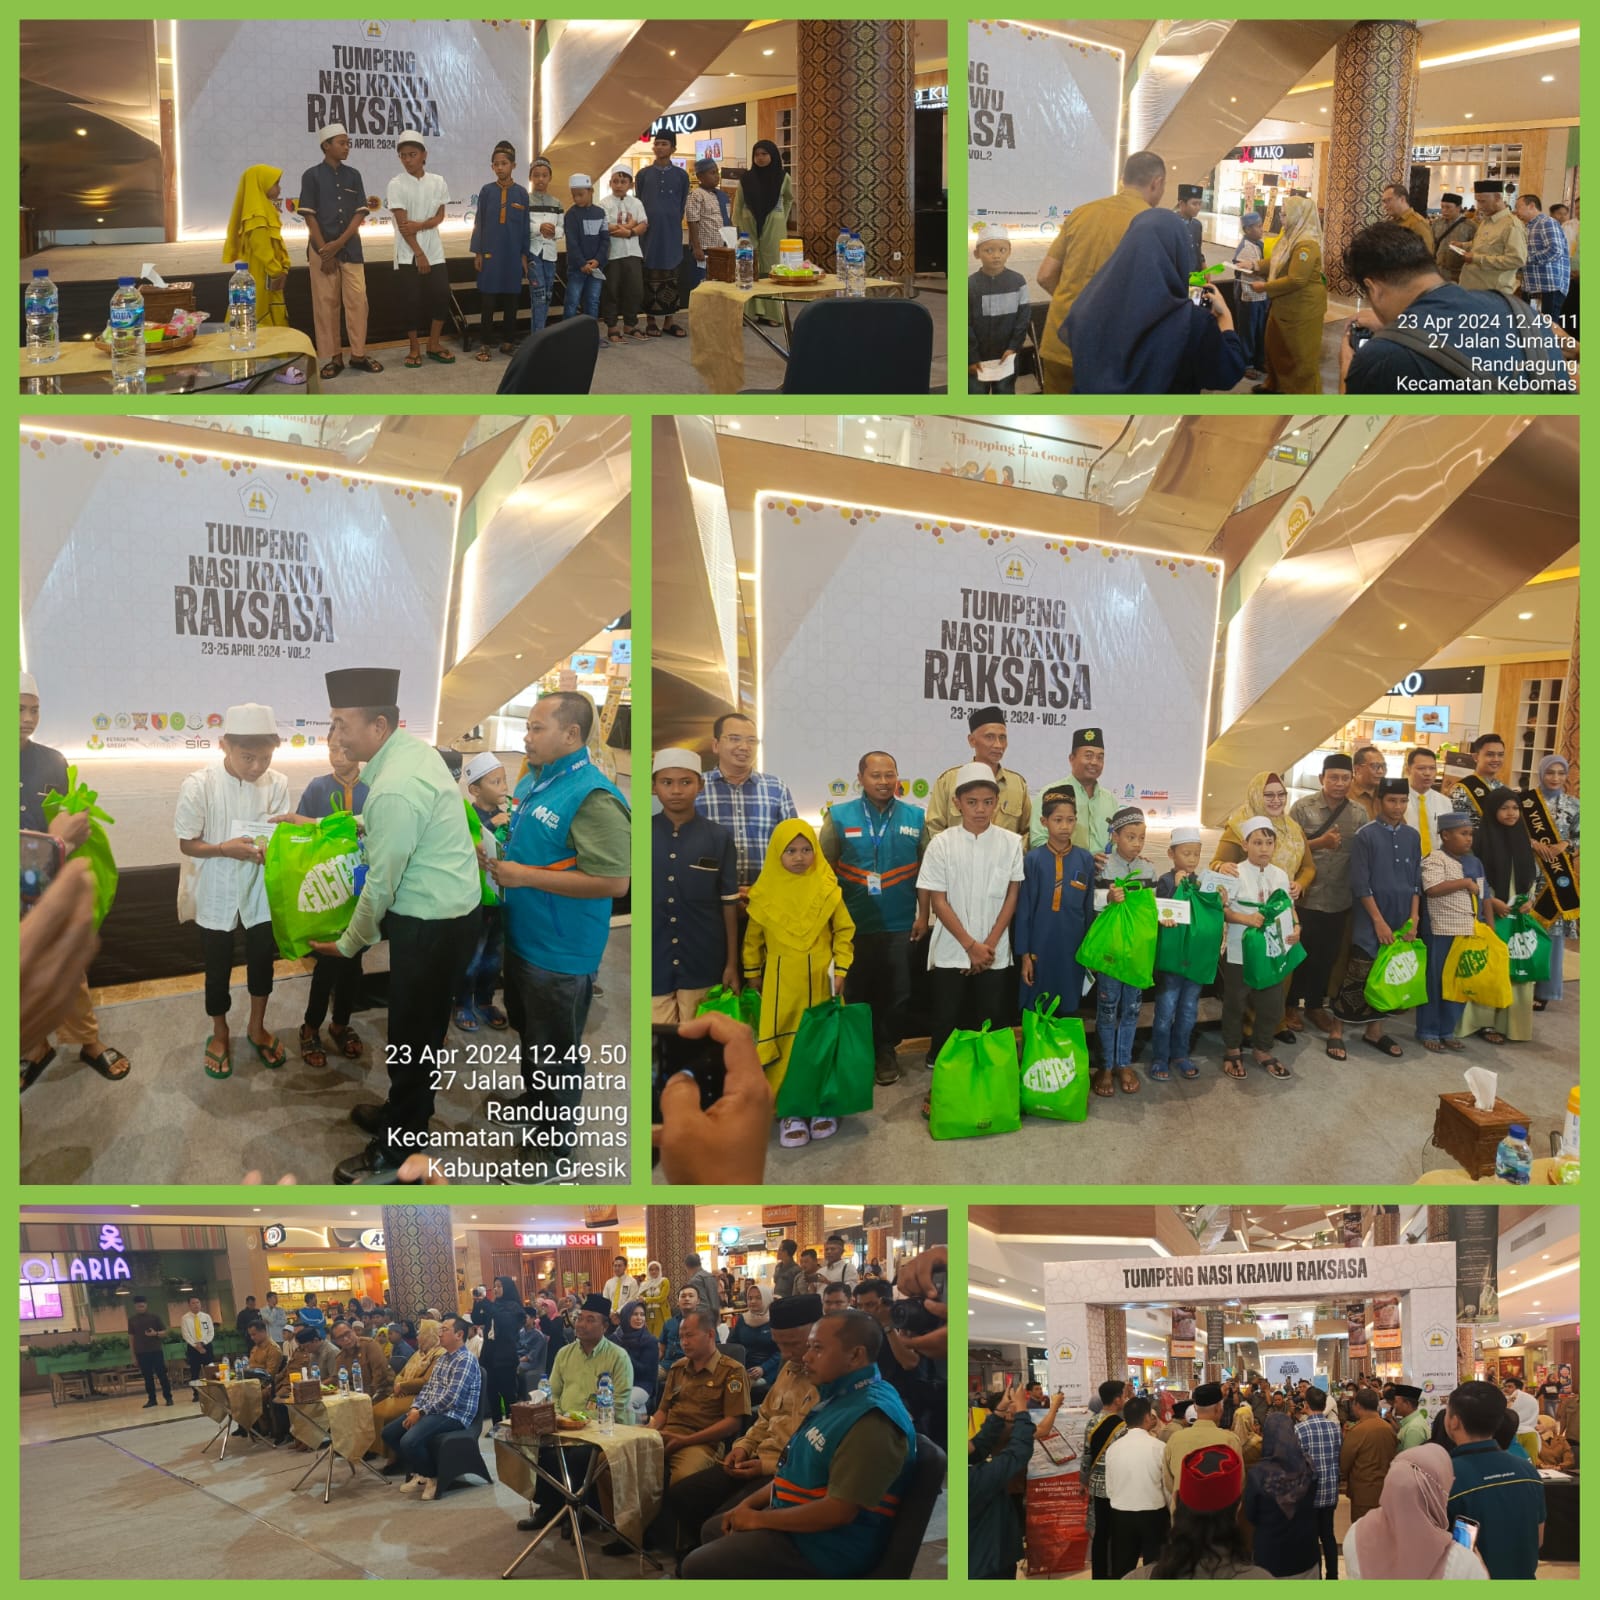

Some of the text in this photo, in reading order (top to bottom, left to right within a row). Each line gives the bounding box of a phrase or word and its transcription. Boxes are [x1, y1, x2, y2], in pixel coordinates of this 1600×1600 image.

[332, 44, 416, 74] TUMPENG
[319, 70, 429, 100] NASI KRAWU
[307, 94, 441, 137] RAKSASA
[651, 113, 697, 135] MAKO
[354, 138, 376, 150] APRIL
[376, 139, 396, 150] 2024
[1254, 146, 1284, 159] MAKO
[111, 310, 132, 321] AQUA
[952, 431, 1015, 457] Shopping
[205, 522, 309, 563] TUMPENG
[188, 555, 323, 595] NASI KRAWU
[174, 585, 335, 643] RAKSASA
[960, 588, 1067, 629] TUMPENG
[201, 641, 230, 656] 23-25
[231, 643, 256, 657] APRIL
[258, 645, 281, 658] 2024
[288, 646, 311, 659] VOL.2
[941, 619, 1081, 663] NASI KRAWU
[924, 649, 1092, 710] RAKSASA
[1010, 711, 1035, 724] 2024
[1042, 712, 1067, 727] VOL.2
[185, 738, 211, 749] SIG
[1529, 810, 1545, 833] YUK
[1540, 836, 1564, 874] GSIK
[369, 1233, 386, 1246] A
[523, 1233, 596, 1246] ICHIBAN SUSHI
[21, 1257, 131, 1282] OLARIA
[1123, 1257, 1368, 1289] TUMPENG NASI KRAWU RAKSASA
